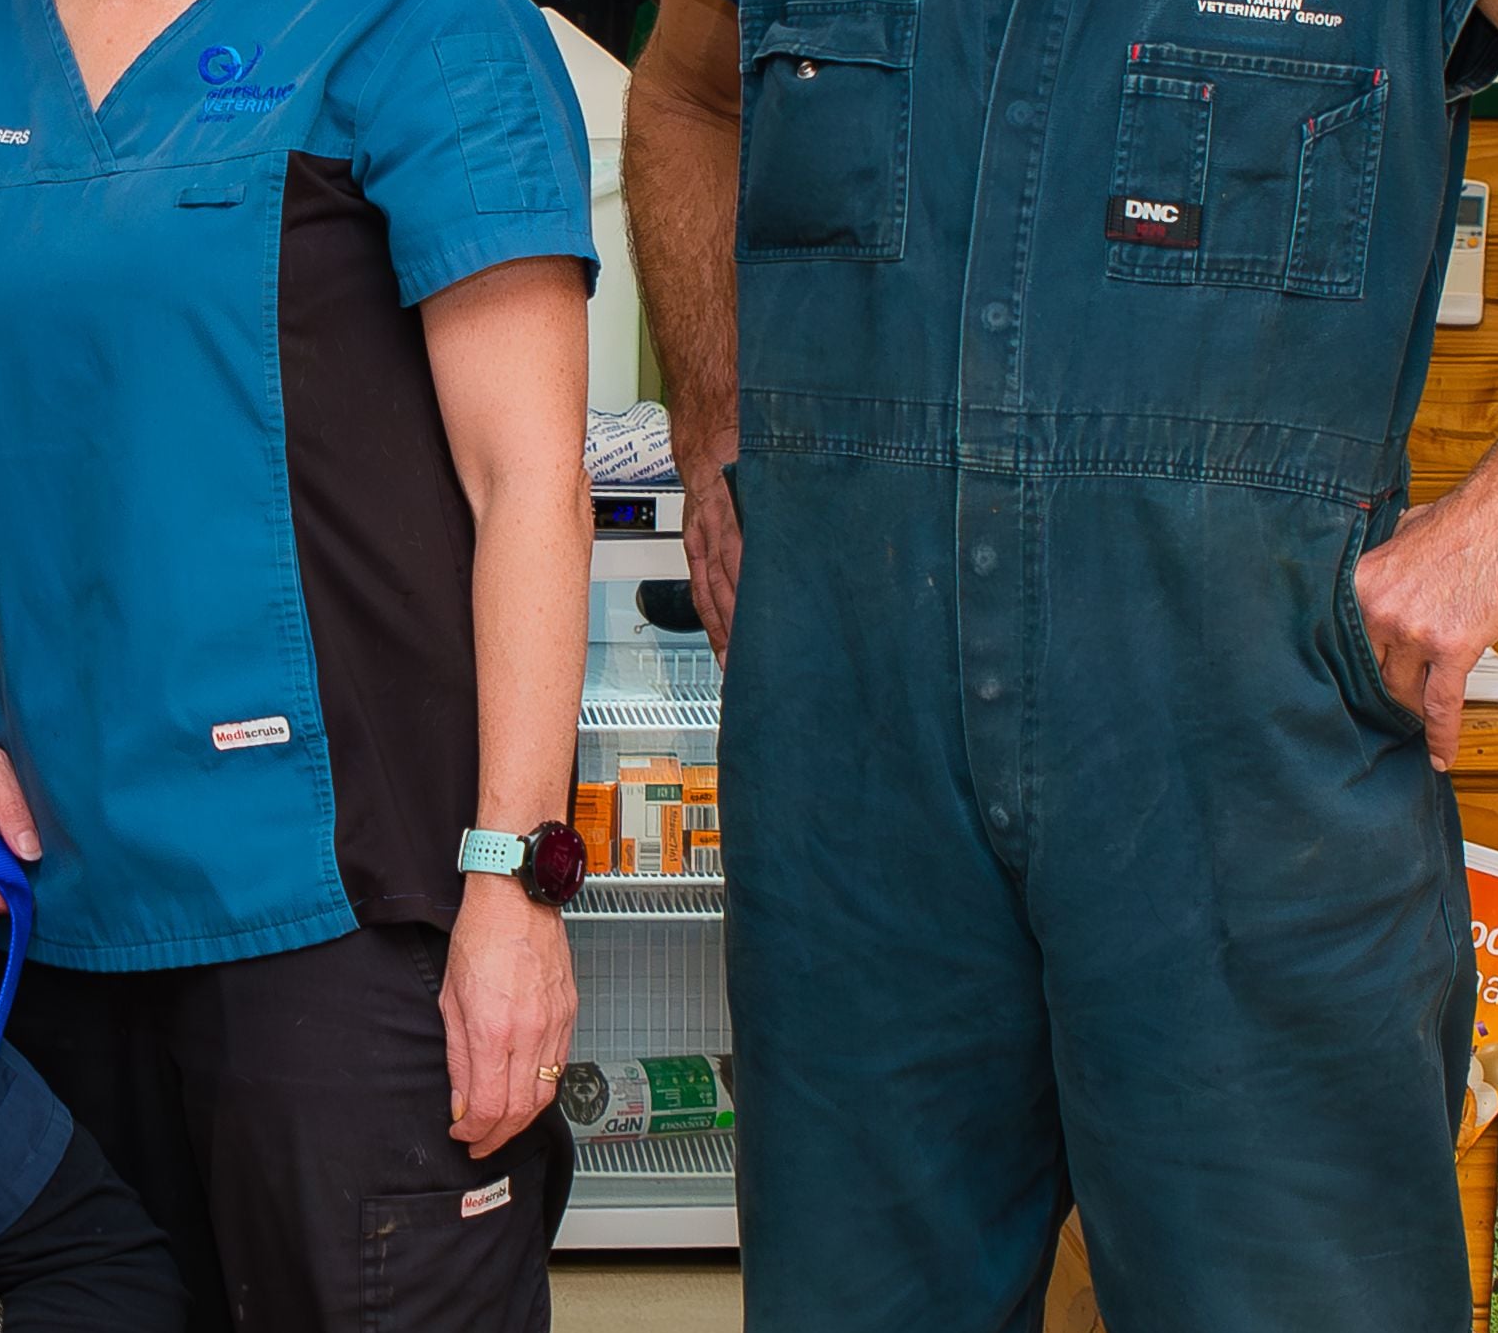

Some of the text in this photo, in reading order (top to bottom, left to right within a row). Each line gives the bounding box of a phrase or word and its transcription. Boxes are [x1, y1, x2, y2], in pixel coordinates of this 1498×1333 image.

[1197, 0, 1343, 28] VETERINARY GROUP
[1125, 199, 1179, 223] DNC
[216, 723, 286, 744] Mediscrubs
